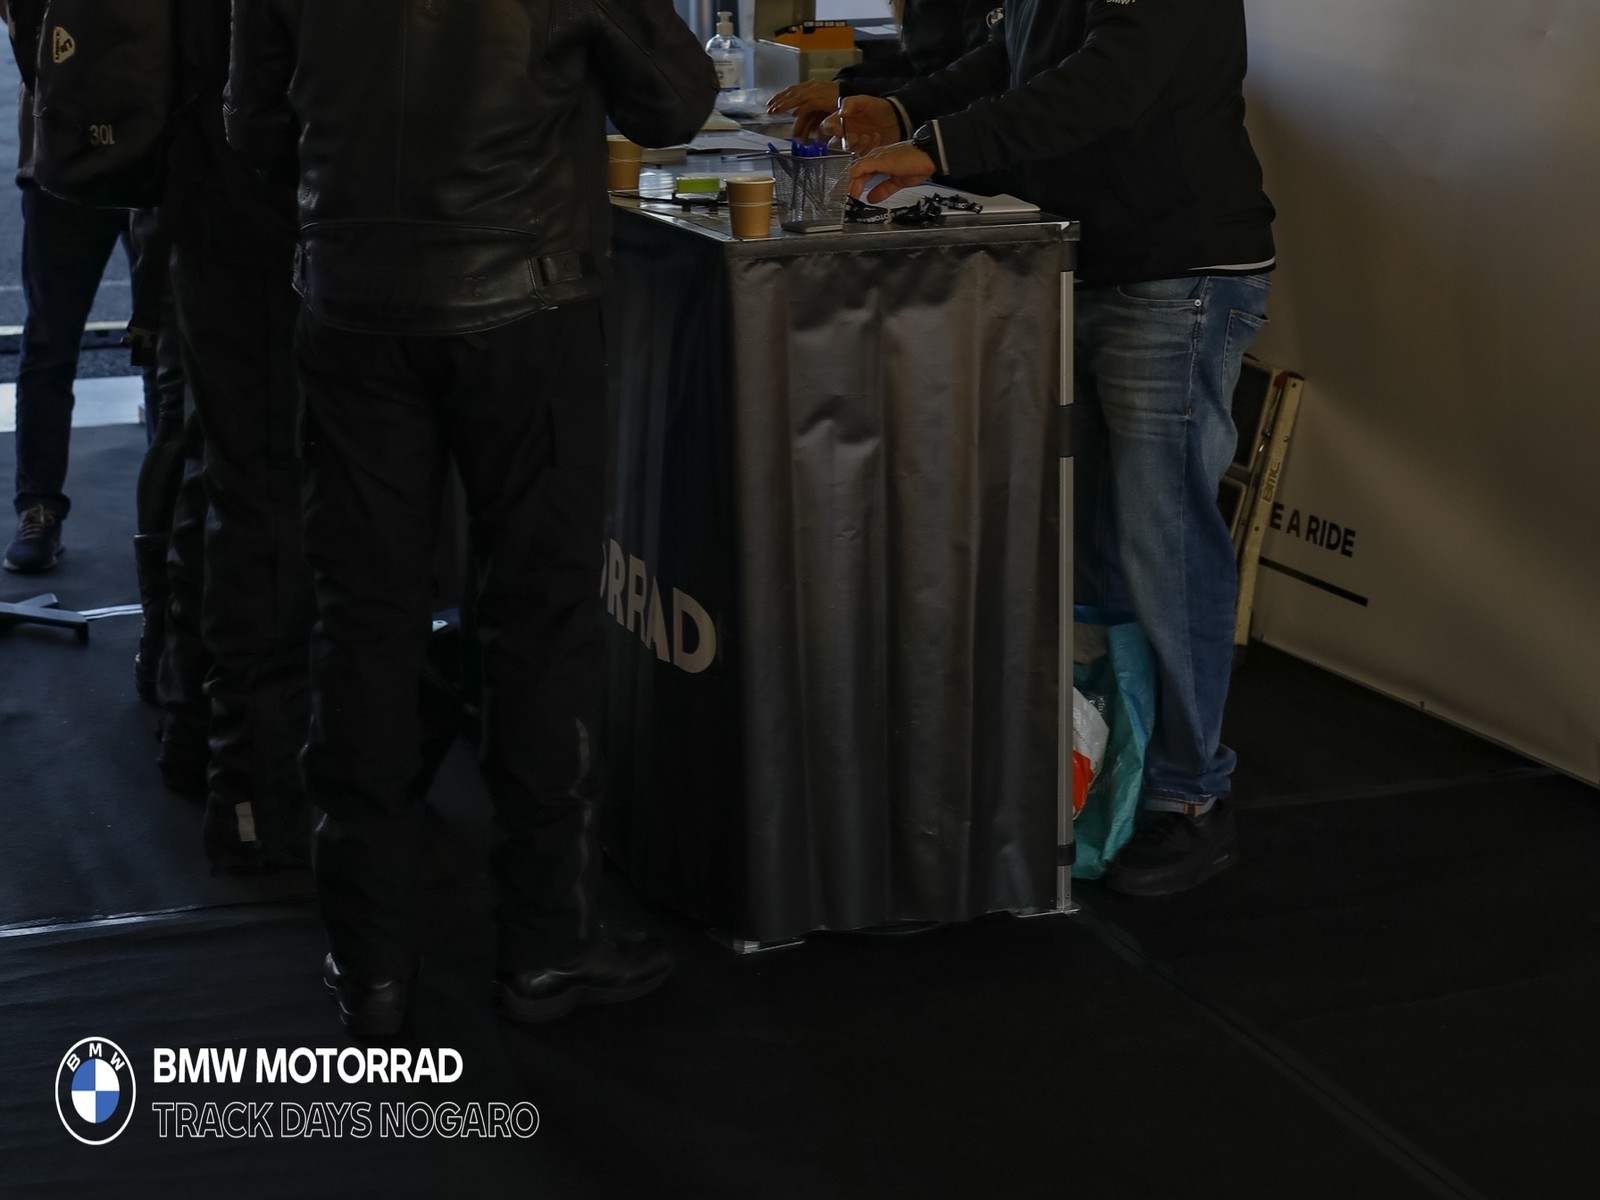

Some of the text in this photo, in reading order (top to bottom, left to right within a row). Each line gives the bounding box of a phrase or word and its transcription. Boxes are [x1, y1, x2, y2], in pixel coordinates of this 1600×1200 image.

[1286, 508, 1301, 538] A
[1305, 514, 1356, 557] RIDE
[600, 537, 718, 674] RRAD
